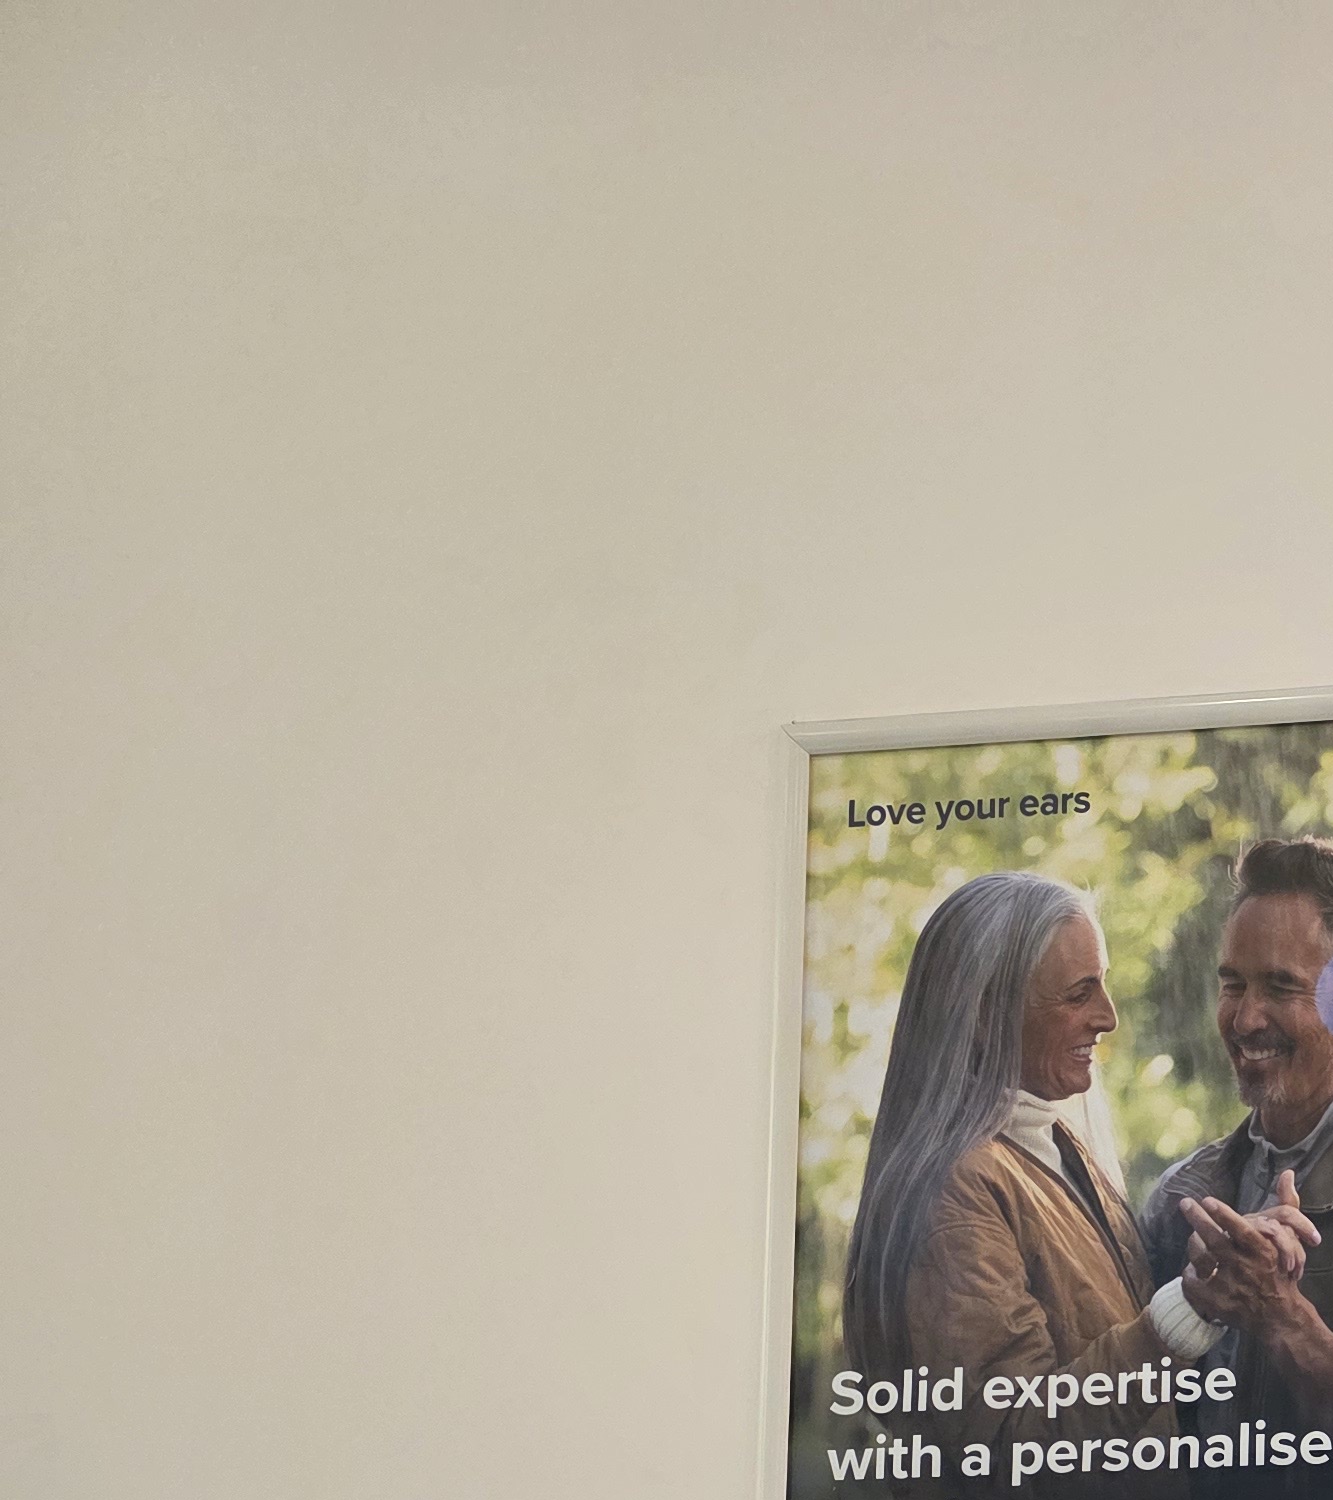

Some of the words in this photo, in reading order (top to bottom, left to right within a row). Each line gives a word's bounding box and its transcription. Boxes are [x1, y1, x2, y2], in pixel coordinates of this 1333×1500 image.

[848, 799, 926, 828] Love
[935, 797, 1010, 830] your
[1019, 791, 1090, 817] ears
[830, 1366, 963, 1415] Solid
[983, 1356, 1236, 1418] expertise
[827, 1433, 941, 1481] with
[961, 1443, 990, 1476] a
